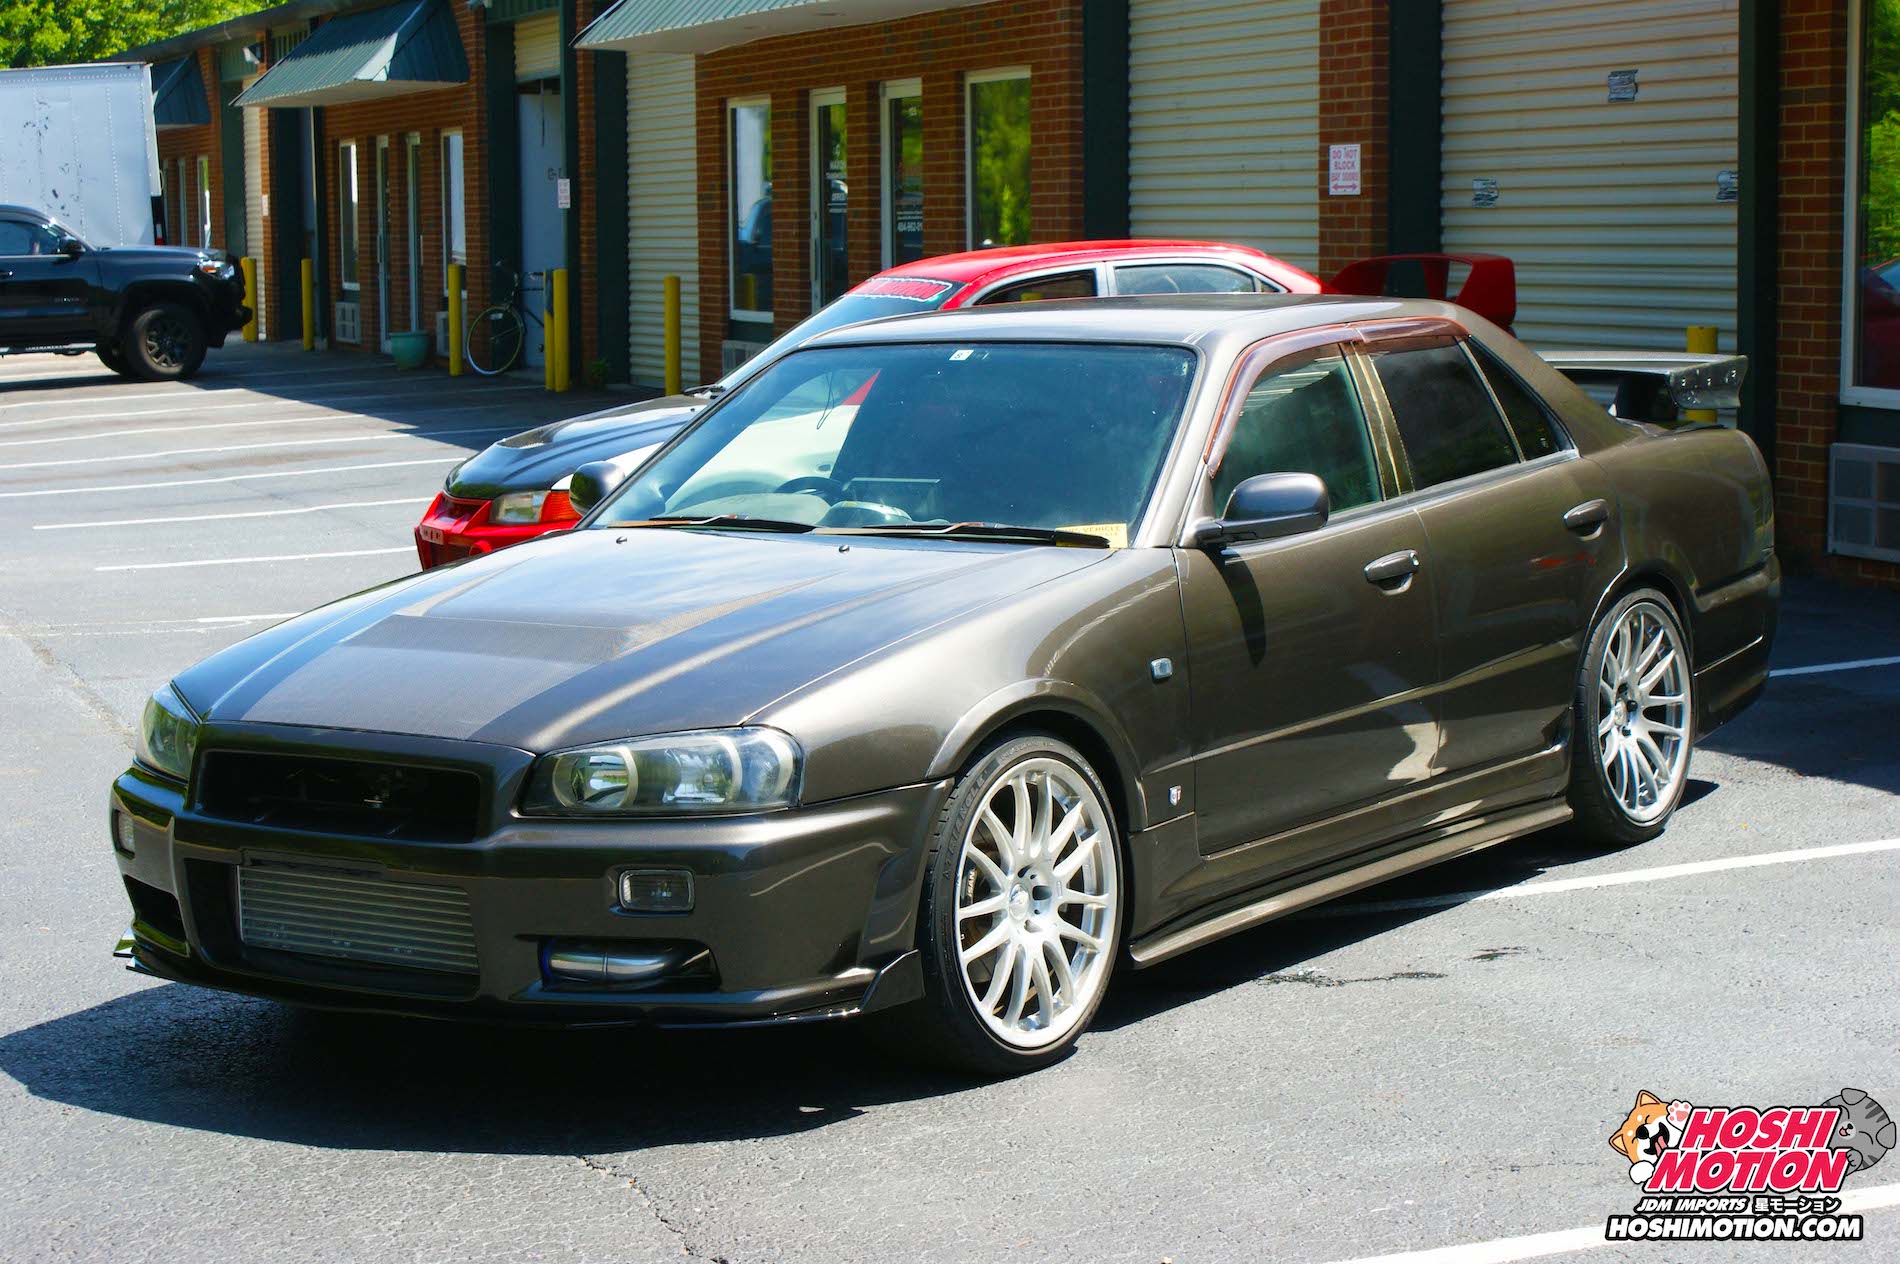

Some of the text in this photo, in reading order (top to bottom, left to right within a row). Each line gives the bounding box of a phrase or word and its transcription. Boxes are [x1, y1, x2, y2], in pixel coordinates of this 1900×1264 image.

[1332, 149, 1357, 160] DO NOT
[1334, 160, 1355, 170] BLOCK
